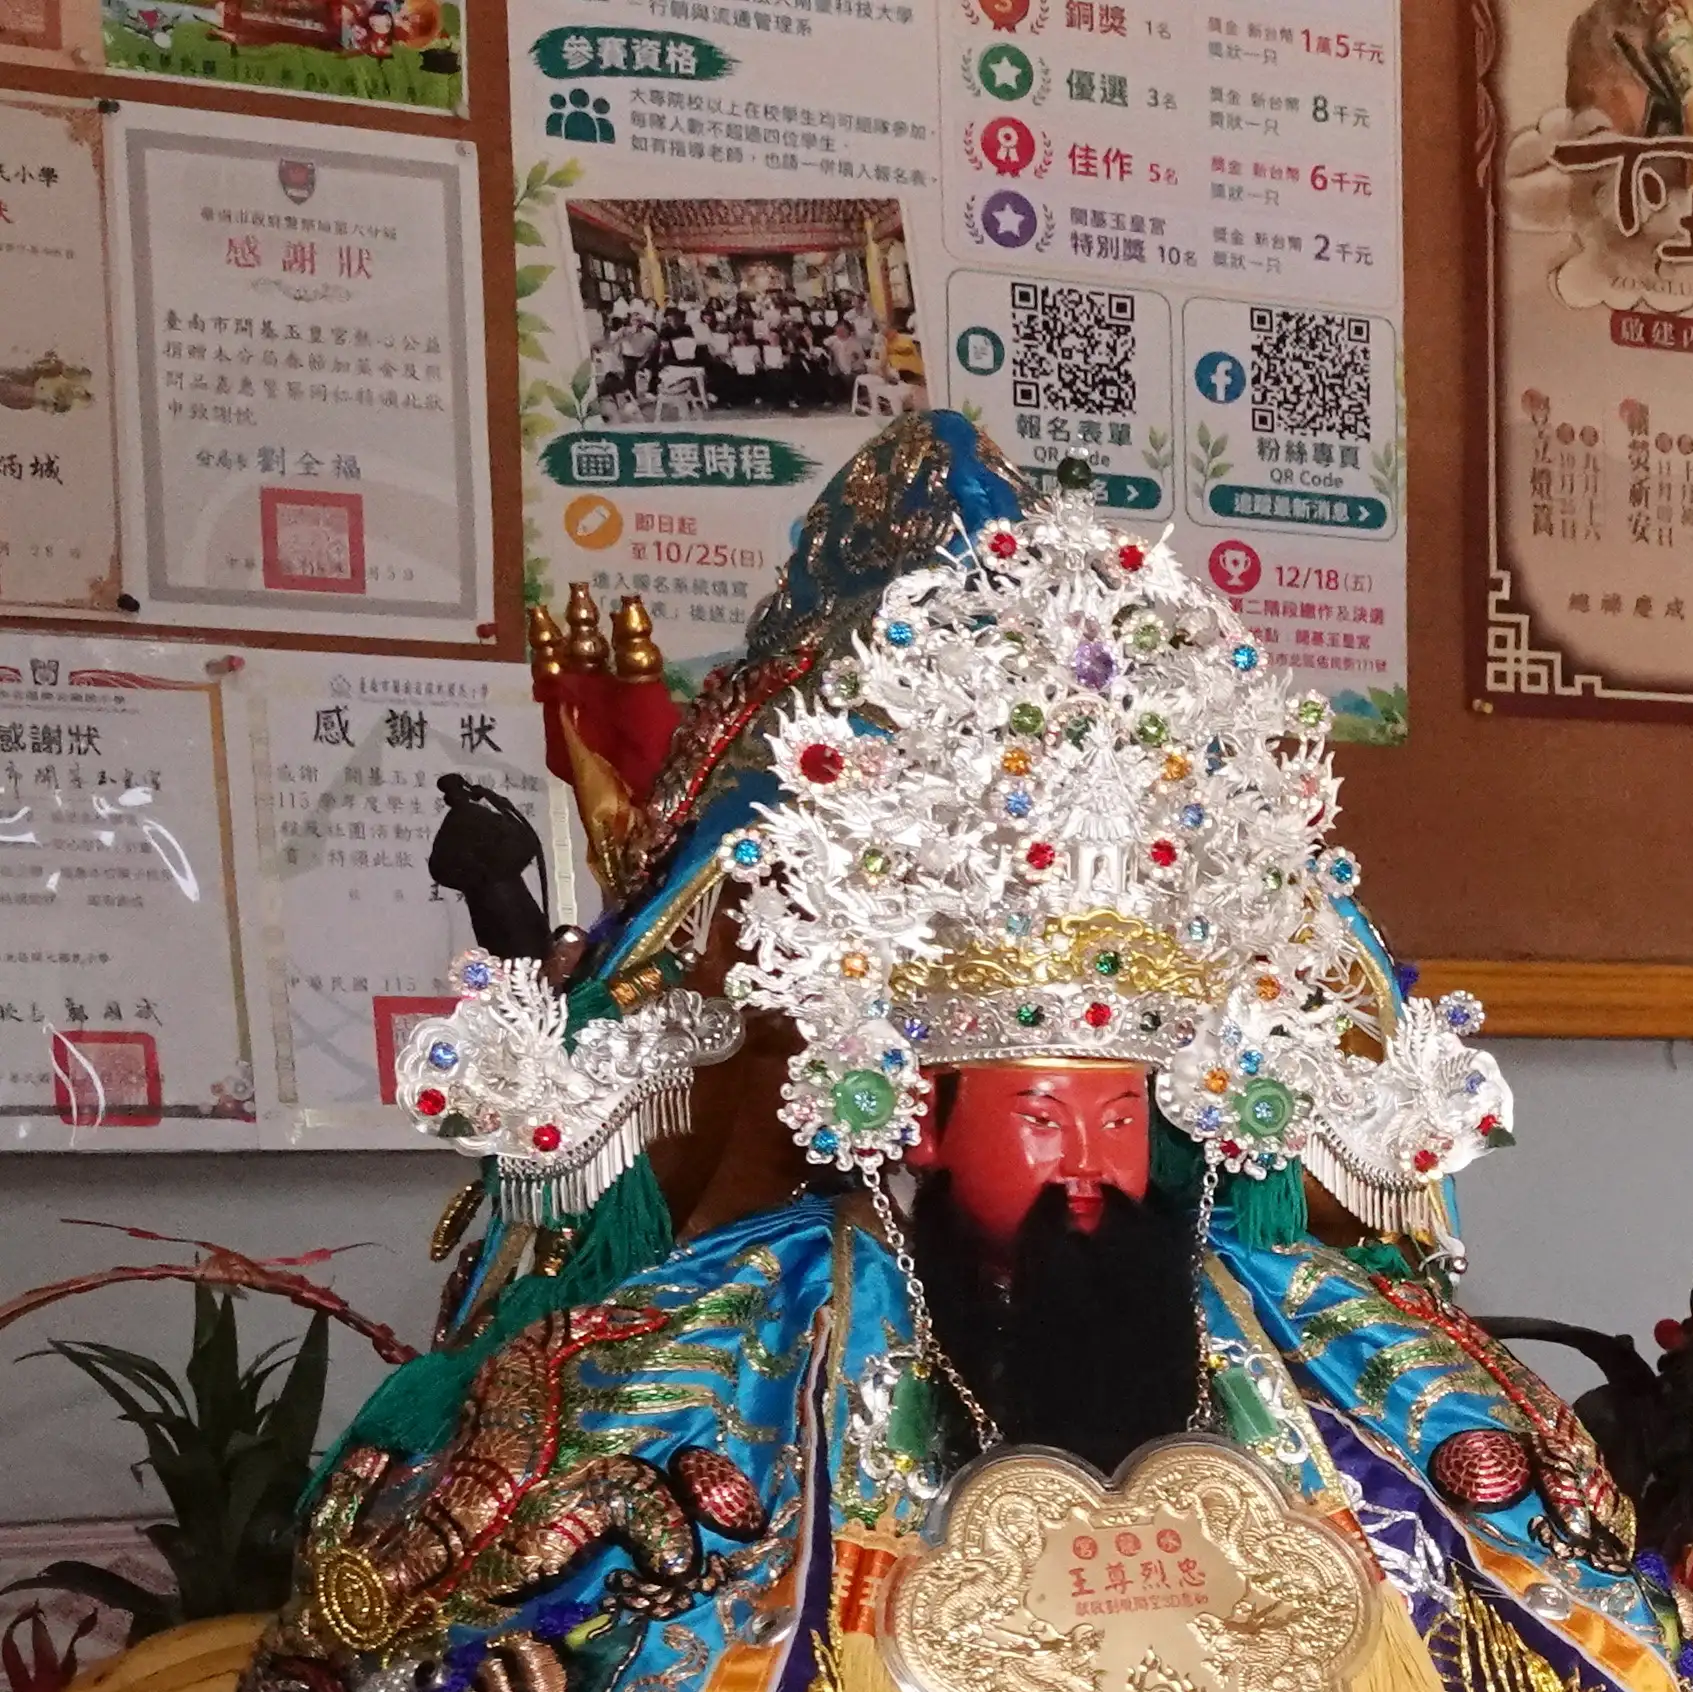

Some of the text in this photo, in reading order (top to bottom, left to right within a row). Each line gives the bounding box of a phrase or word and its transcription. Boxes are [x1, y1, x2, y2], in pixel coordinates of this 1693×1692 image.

[649, 3, 812, 36] 行銷與流通管理系
[1066, 0, 1171, 40] 銅獎 1名
[562, 35, 698, 75] 參賽資格
[1302, 29, 1385, 65] 1萬5千元
[1067, 68, 1177, 110] 優選 3名
[1312, 95, 1371, 129] 8千元
[1068, 143, 1178, 186] 佳作 5名
[1310, 165, 1372, 197] 6千元
[1070, 206, 1166, 237] 開基玉皇宮
[226, 234, 373, 280] 感謝狀
[1070, 230, 1198, 267] 特別獎 10名
[1314, 234, 1374, 267] 2千元
[1016, 413, 1132, 447] 報名表單
[631, 442, 774, 481] 重要時程
[1033, 445, 1059, 464] QR
[1257, 437, 1360, 471] 粉絲專頁
[1270, 468, 1344, 488] QR Code
[635, 512, 698, 536] 即日起
[314, 704, 503, 754] 感謝狀
